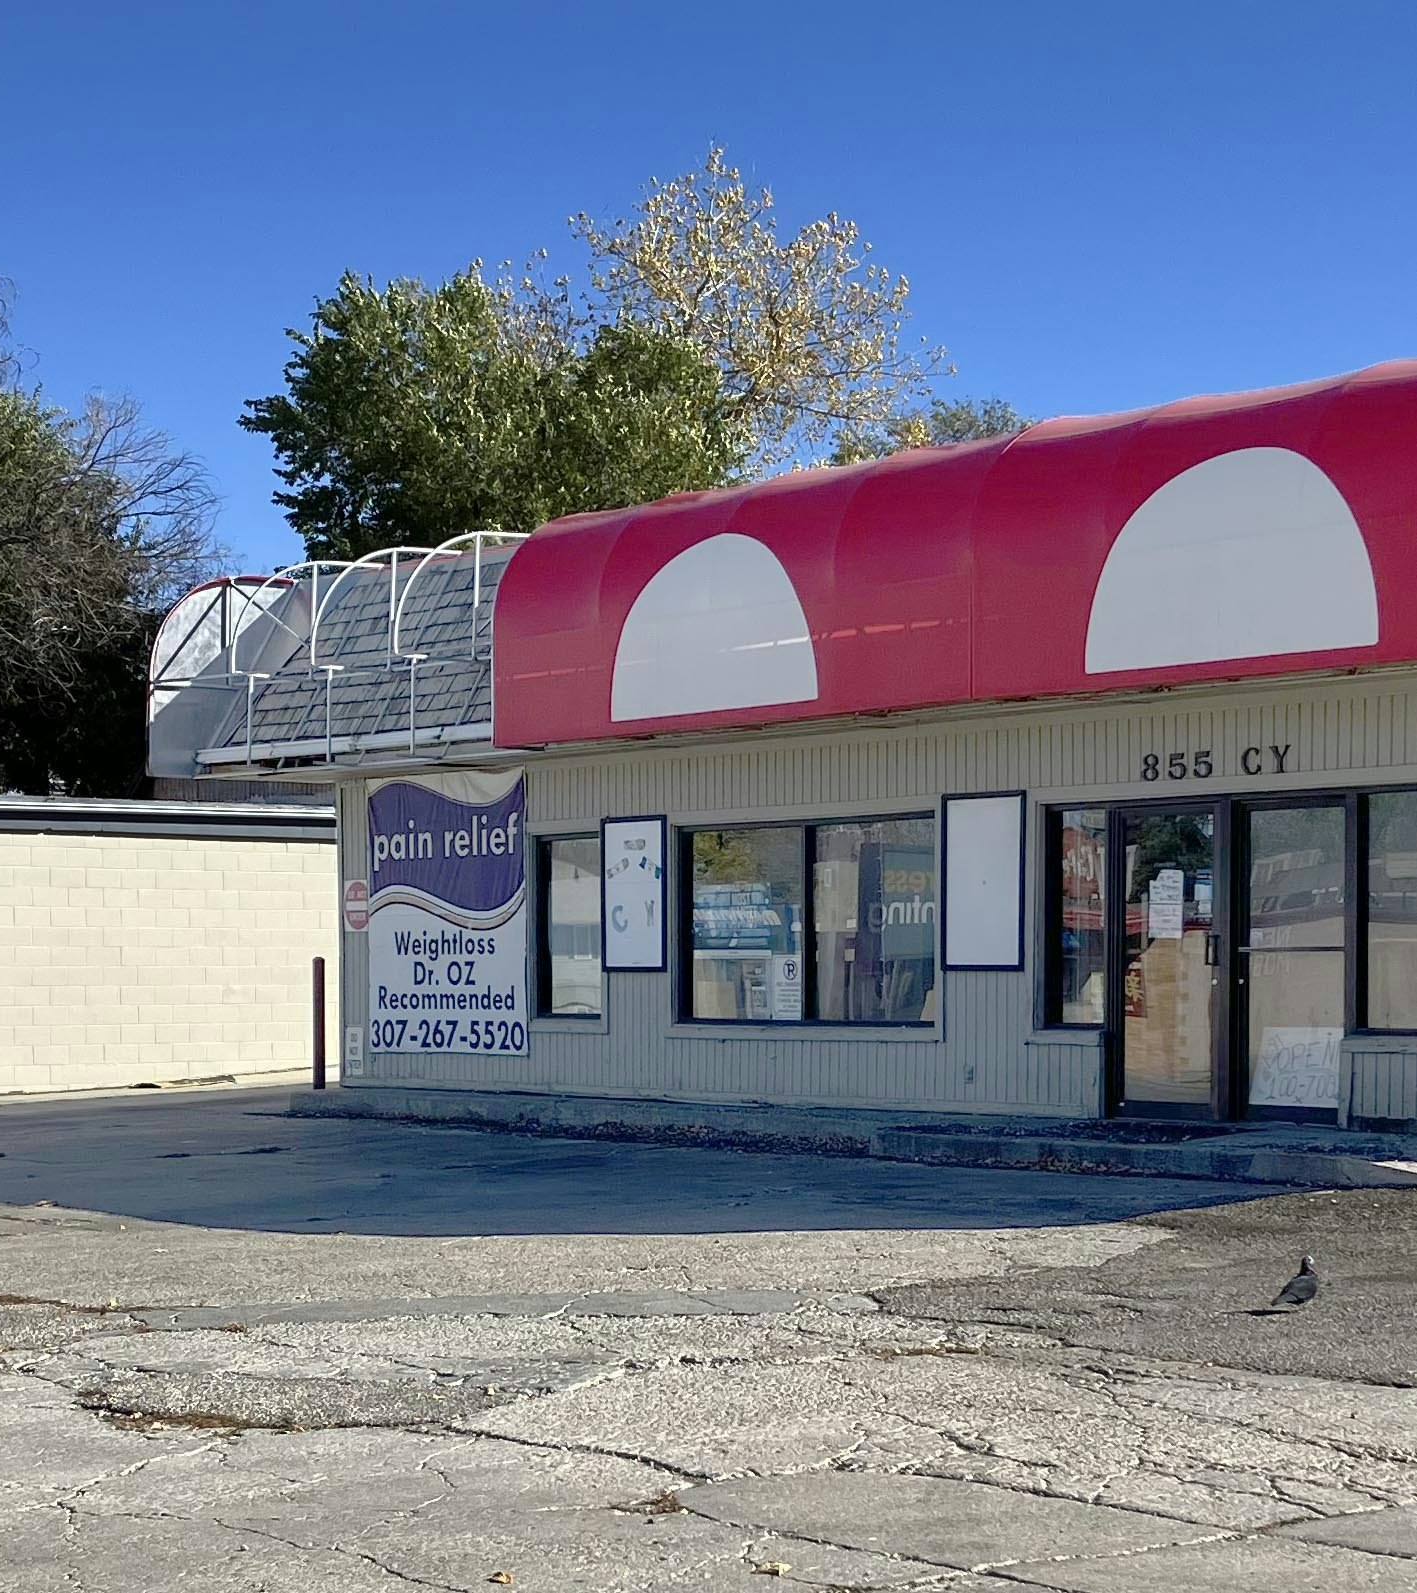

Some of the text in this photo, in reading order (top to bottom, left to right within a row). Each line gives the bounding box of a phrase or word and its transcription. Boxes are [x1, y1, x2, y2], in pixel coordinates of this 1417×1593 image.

[1142, 744, 1291, 782] 855 CY
[374, 812, 518, 871] pain relief
[394, 930, 495, 961] Weightloss
[414, 961, 476, 986] Dr. OZ
[378, 985, 515, 1010] Recommended
[371, 1018, 525, 1051] 307-267-5520
